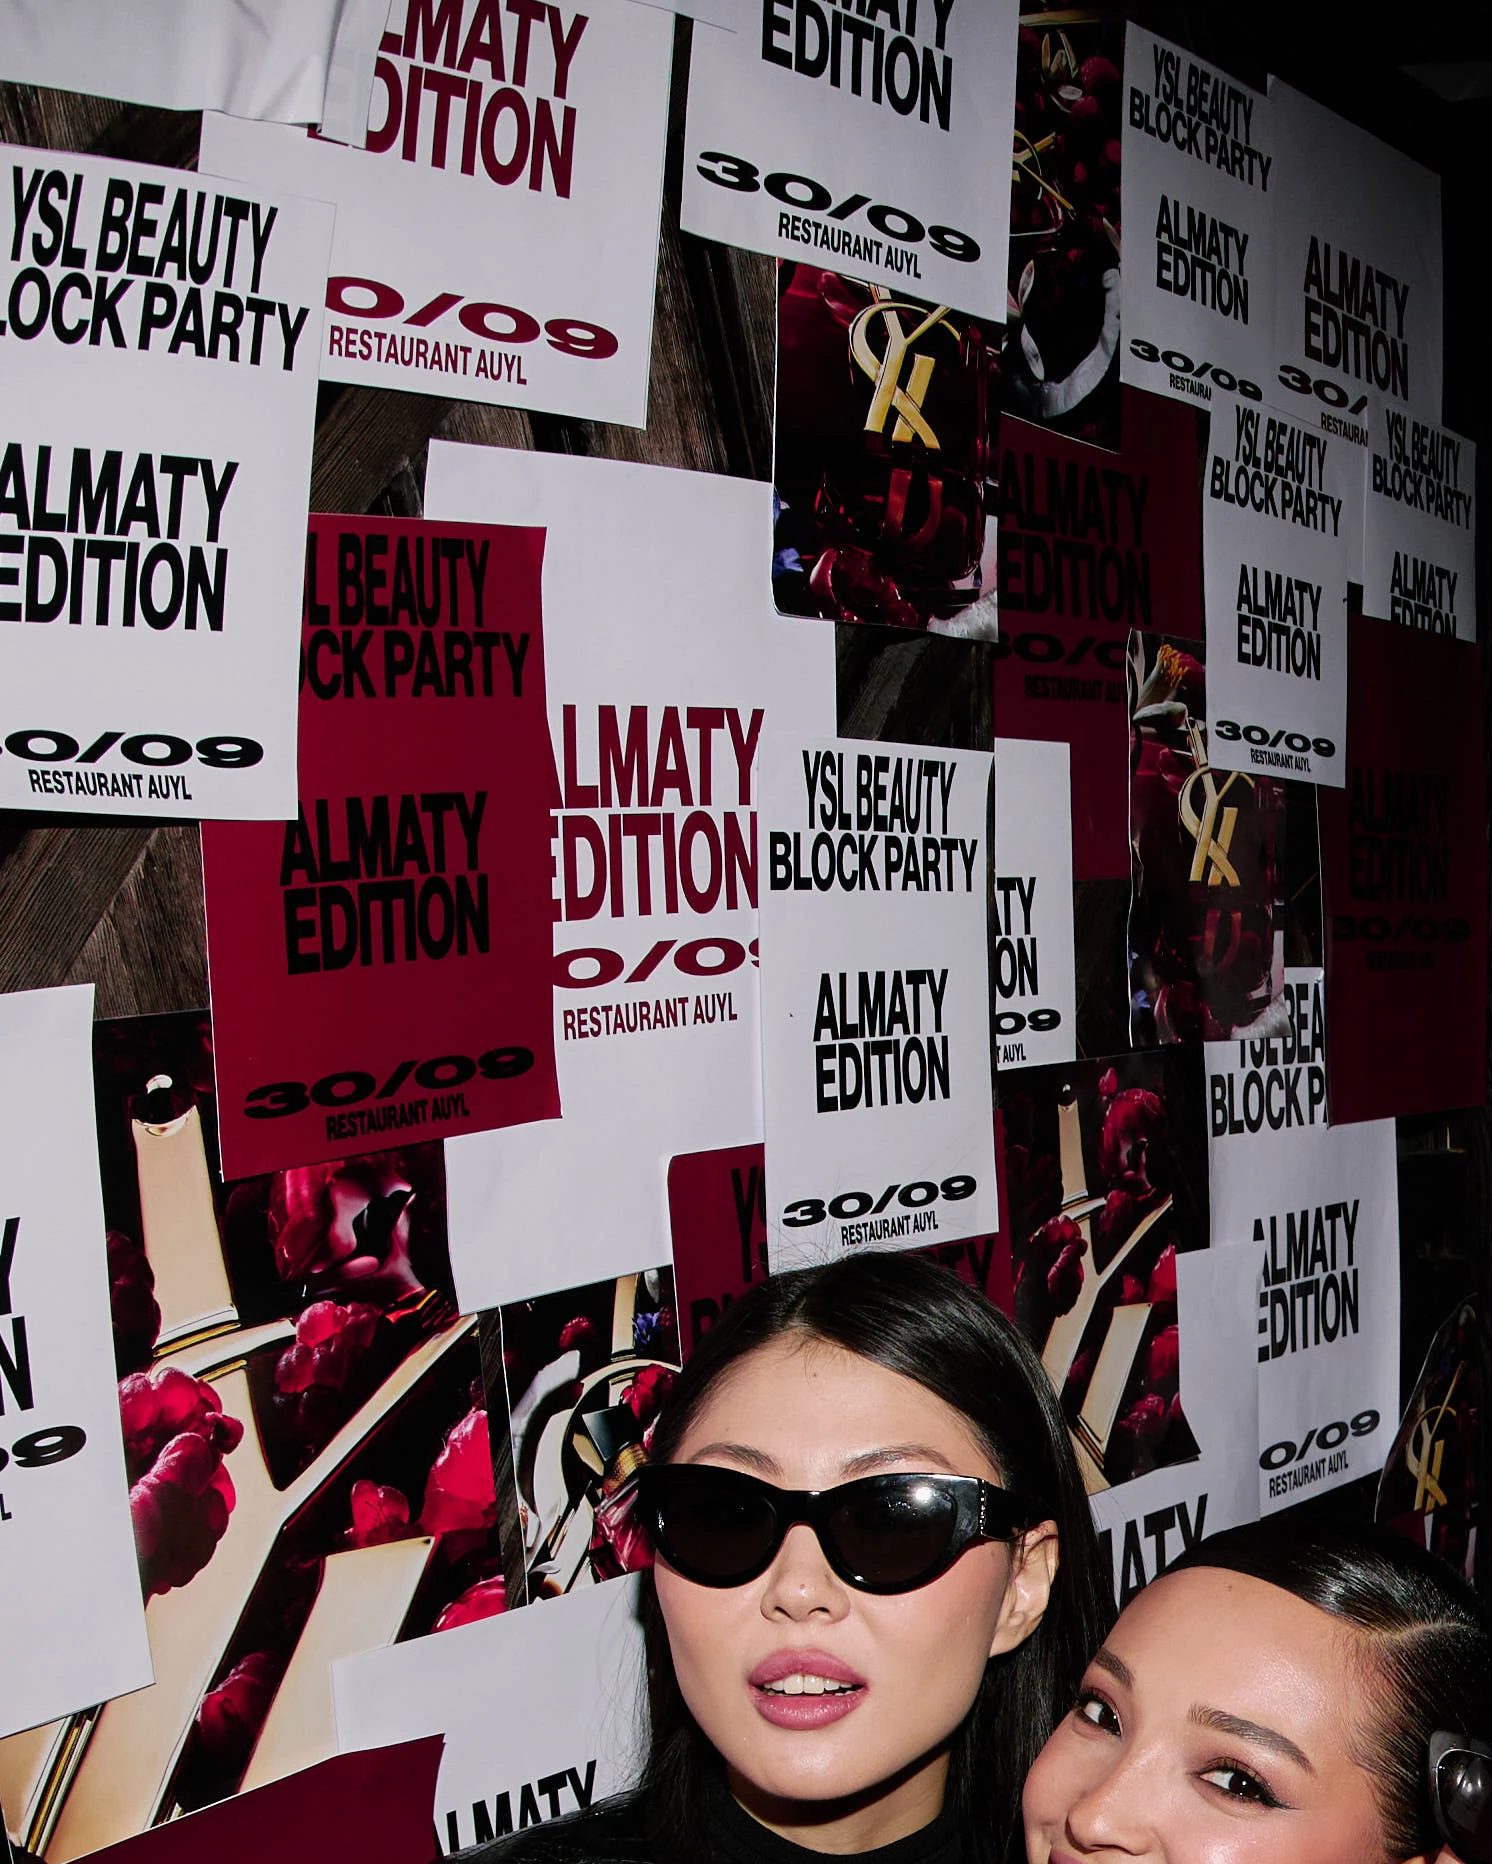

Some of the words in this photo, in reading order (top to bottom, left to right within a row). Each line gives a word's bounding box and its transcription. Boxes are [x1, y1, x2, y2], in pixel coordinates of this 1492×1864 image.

[379, 0, 588, 100] MATY
[761, 0, 953, 132] EDITION
[308, 56, 576, 198] DITION
[1154, 44, 1184, 111] YSL
[1188, 61, 1254, 145] BEAUTY
[1129, 88, 1202, 160] BLOCK
[1205, 127, 1272, 191] PARTY
[11, 166, 86, 268] YSL
[96, 179, 278, 293] BEAUTY
[696, 151, 981, 262] 30/09
[1156, 195, 1248, 277] ALMATY
[779, 212, 883, 266] RESTAURANT
[885, 252, 921, 279] AUYL
[1156, 240, 1248, 325] EDITION
[0, 268, 134, 348] OCK
[138, 280, 309, 371] PARTY
[1304, 236, 1409, 338] ALMATY
[329, 326, 471, 378] RESTAURANT
[475, 352, 527, 385] AUYL
[1130, 339, 1263, 401] 30/09
[1304, 296, 1408, 401] EDITION
[1236, 404, 1261, 470] YSL
[1263, 418, 1327, 491] BEAUTY
[1386, 409, 1410, 465] YSL
[1411, 421, 1460, 488] BEAUTY
[0, 443, 239, 541] ALMATY
[998, 449, 1148, 547] ALMATY
[1210, 456, 1278, 517] BLOCK
[1281, 482, 1342, 536] PARTY
[1372, 454, 1424, 512] BLOCK
[1426, 478, 1471, 529] PARTY
[337, 533, 489, 628] BEAUTY
[1000, 534, 1152, 625] EDITION
[1237, 564, 1321, 630] ALMATY
[1390, 551, 1457, 613] ALMATY
[384, 631, 530, 697] PARTY
[1237, 615, 1320, 681] EDITION
[0, 729, 264, 768] 0/09
[552, 704, 765, 809] LMATY
[1215, 720, 1336, 757] 30/09
[1250, 748, 1294, 771] RESTAURANT
[1295, 756, 1311, 773] AUYL
[28, 769, 143, 799] RESTAURANT
[149, 774, 192, 799] AUYL
[802, 750, 851, 831] YSL
[857, 755, 956, 835] BEAUTY
[280, 791, 487, 886] ALMATY
[770, 831, 880, 891] BLOCK
[885, 836, 977, 892] PARTY
[285, 874, 490, 974] EDITION
[995, 877, 1036, 936] TY
[554, 937, 759, 988] 0/0
[563, 996, 689, 1040] RESTAURANT
[693, 992, 738, 1026] AUYL
[814, 968, 948, 1042] ALMATY
[244, 1046, 534, 1119] 30/09
[816, 1036, 950, 1113] EDITION
[1211, 1068, 1304, 1137] BLOCK
[326, 1099, 428, 1141] RESTAURANT
[432, 1094, 470, 1121] AUYL
[782, 1175, 976, 1228] 30/09
[841, 1215, 910, 1246] RESTAURANT
[912, 1211, 939, 1233] AUYL
[1260, 1410, 1380, 1470] 0/09
[1269, 1462, 1326, 1498] RESTAURANT
[1328, 1450, 1349, 1479] AUYL
